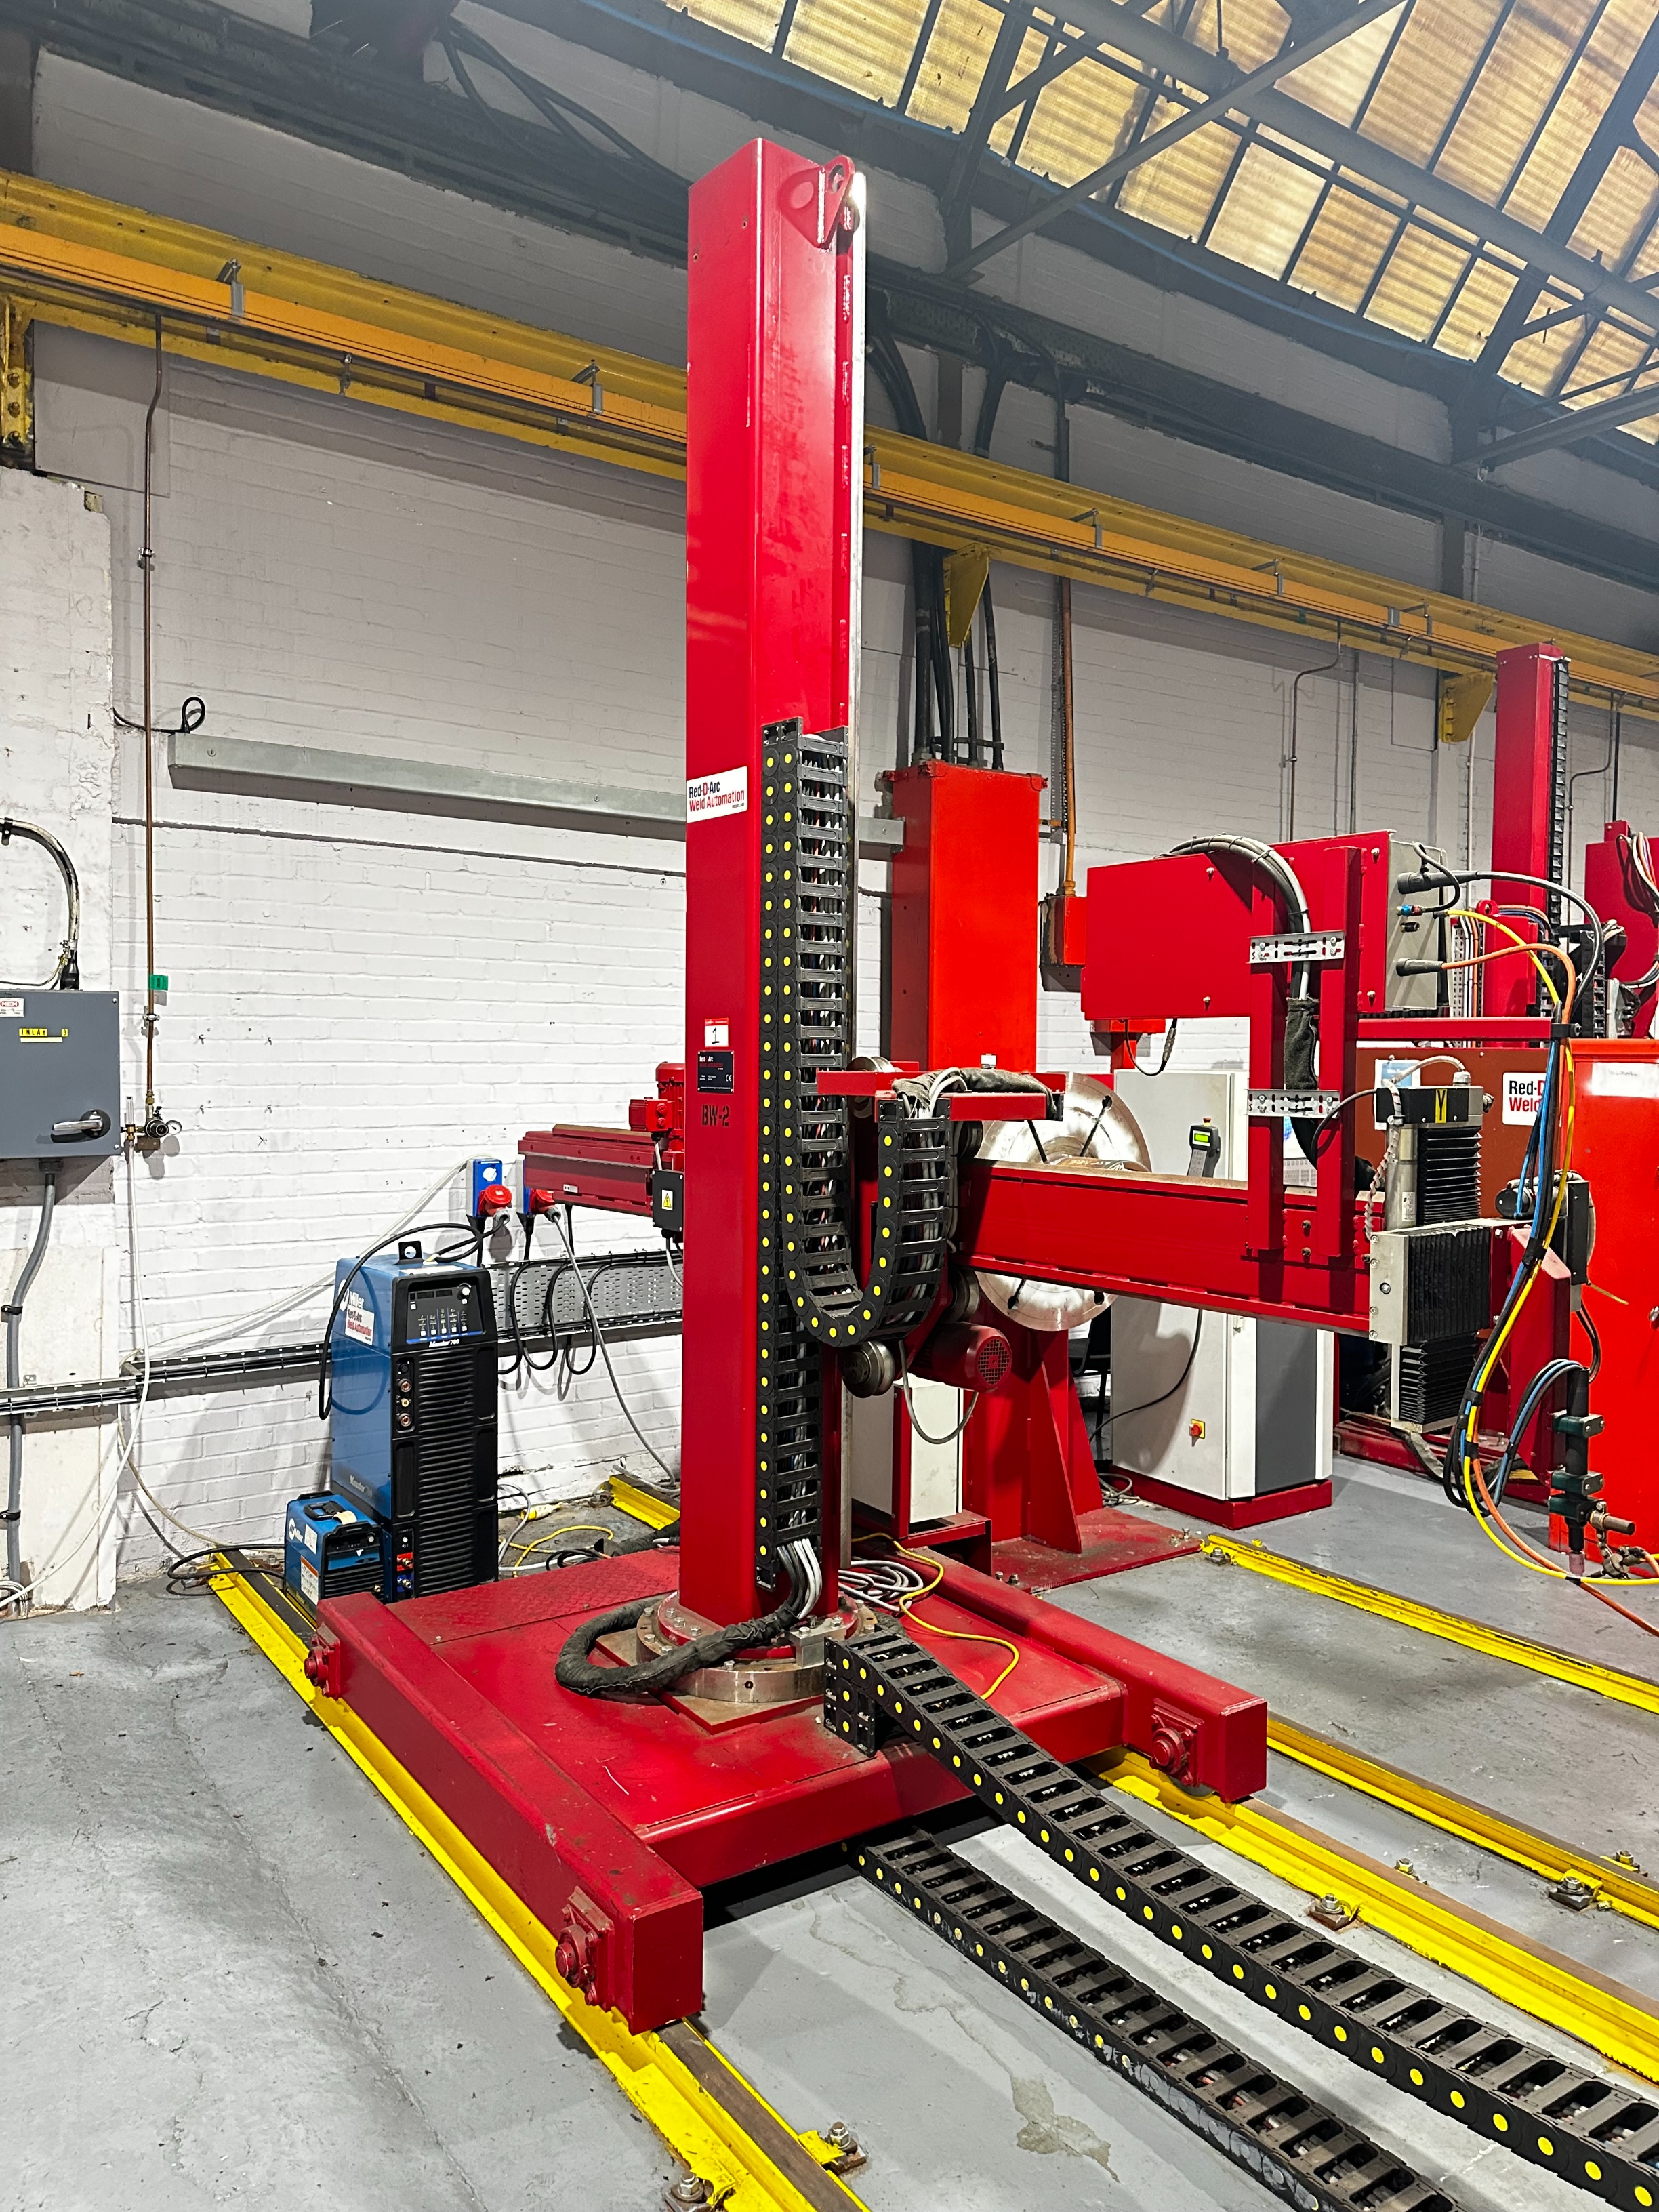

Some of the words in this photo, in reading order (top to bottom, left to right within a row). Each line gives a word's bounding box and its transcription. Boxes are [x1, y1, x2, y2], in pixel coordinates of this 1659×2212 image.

[689, 797, 705, 812] Weld
[706, 790, 745, 808] Automation
[712, 1027, 720, 1044] 1
[701, 1104, 730, 1127] BW-2
[1437, 1090, 1446, 1121] Y
